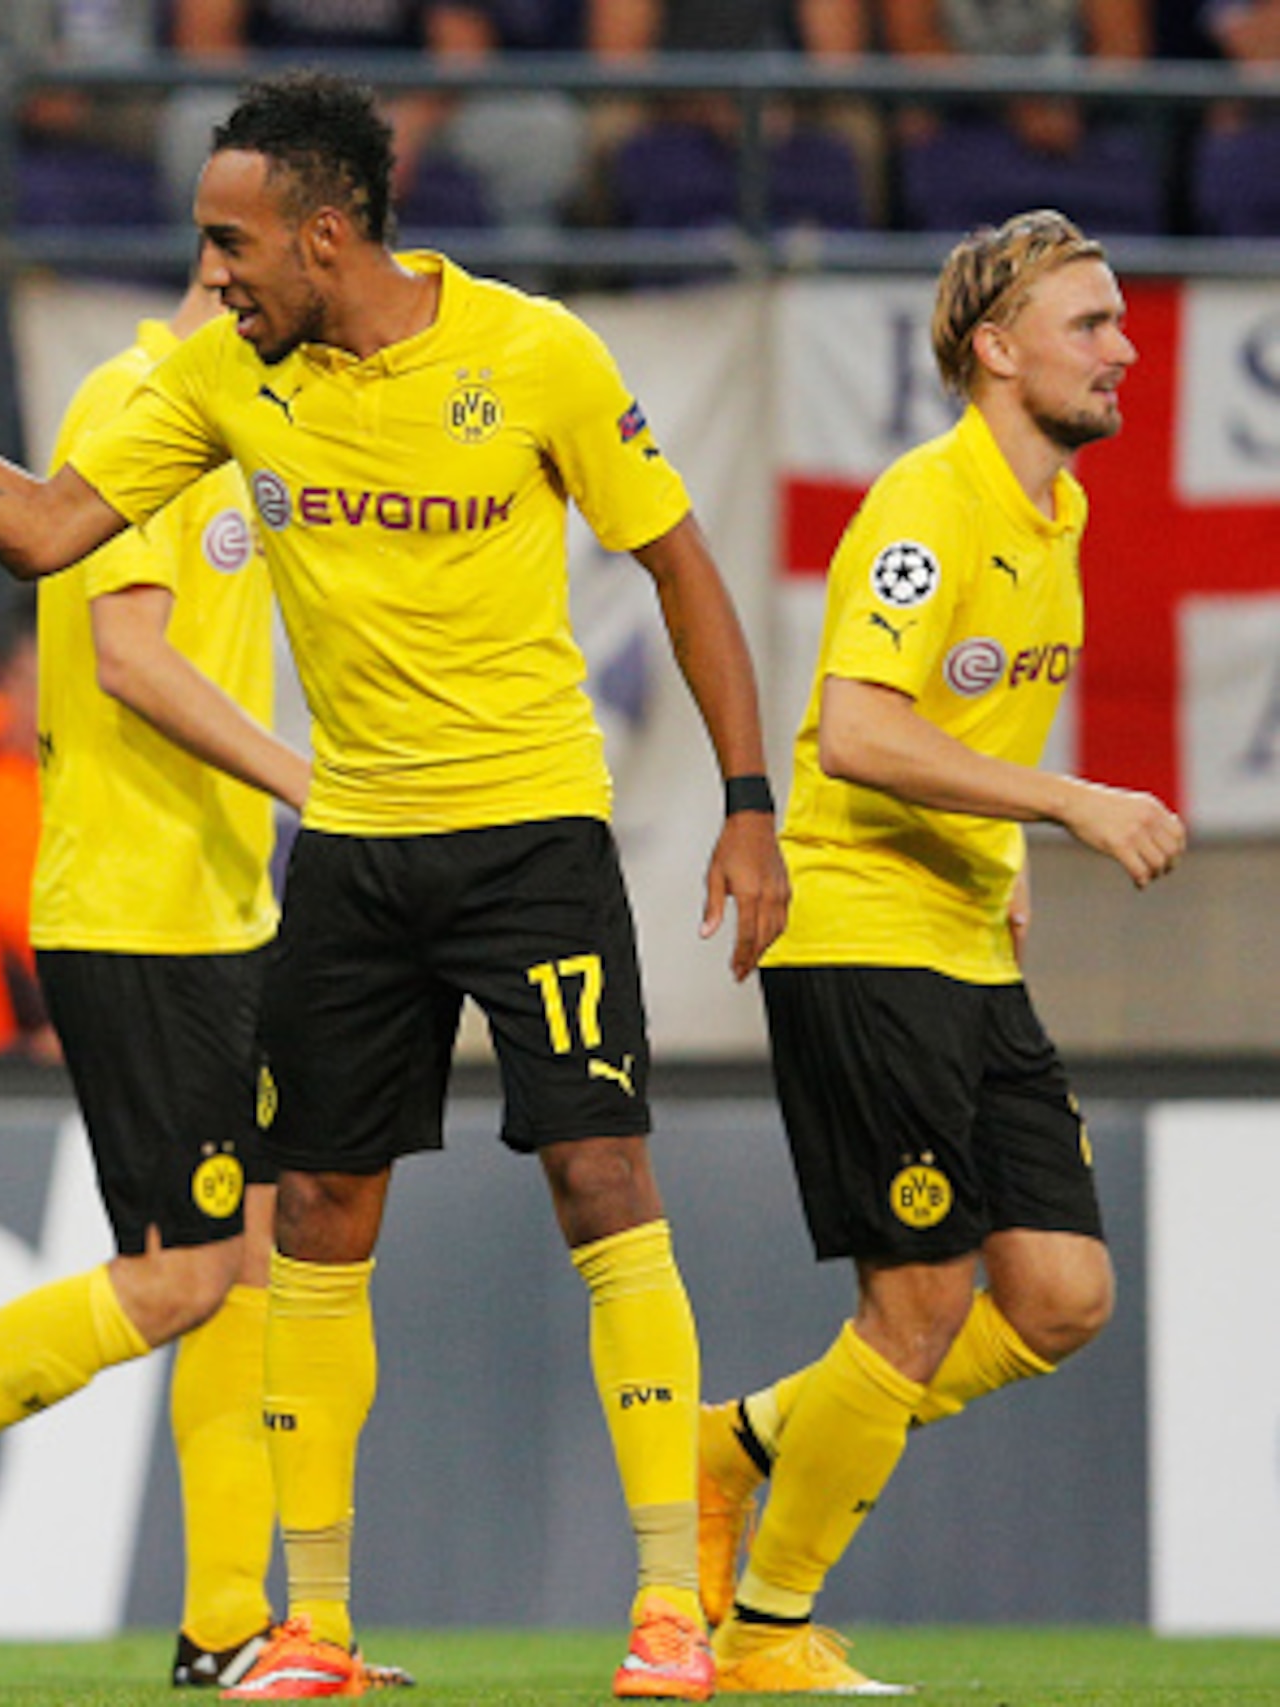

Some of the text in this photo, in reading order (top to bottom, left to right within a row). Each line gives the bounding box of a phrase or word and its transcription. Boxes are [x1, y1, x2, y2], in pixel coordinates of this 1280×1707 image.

[453, 392, 496, 427] BVB
[297, 488, 516, 532] EVONIK
[527, 954, 602, 1054] 17
[901, 1172, 945, 1207] BVB
